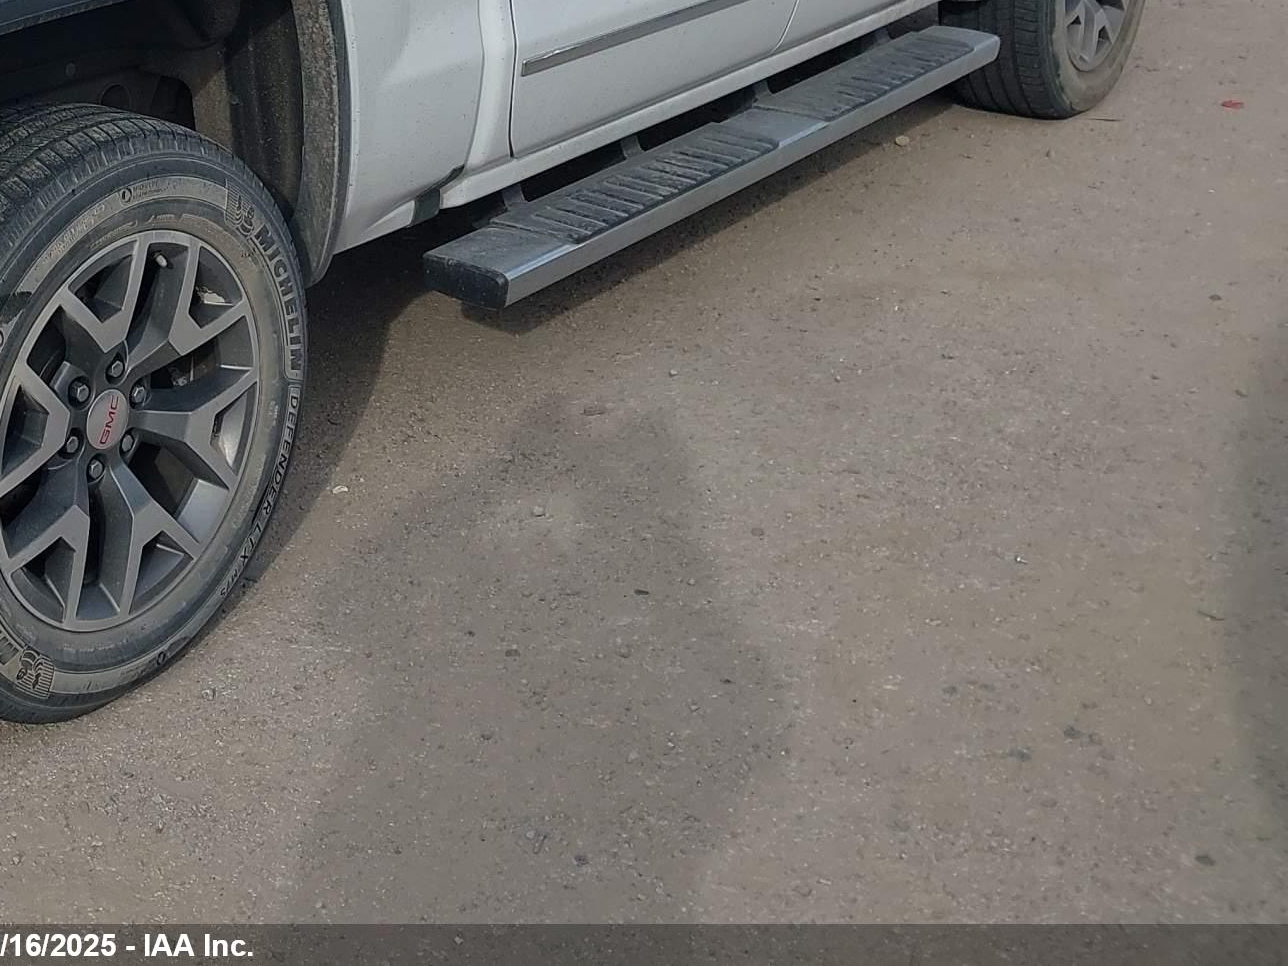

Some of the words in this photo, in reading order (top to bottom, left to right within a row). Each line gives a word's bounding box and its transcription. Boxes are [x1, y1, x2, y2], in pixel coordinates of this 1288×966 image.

[255, 224, 302, 371] MICHELIN
[100, 394, 119, 444] GMC
[263, 395, 299, 515] DEFENDER
[240, 523, 262, 566] LTX
